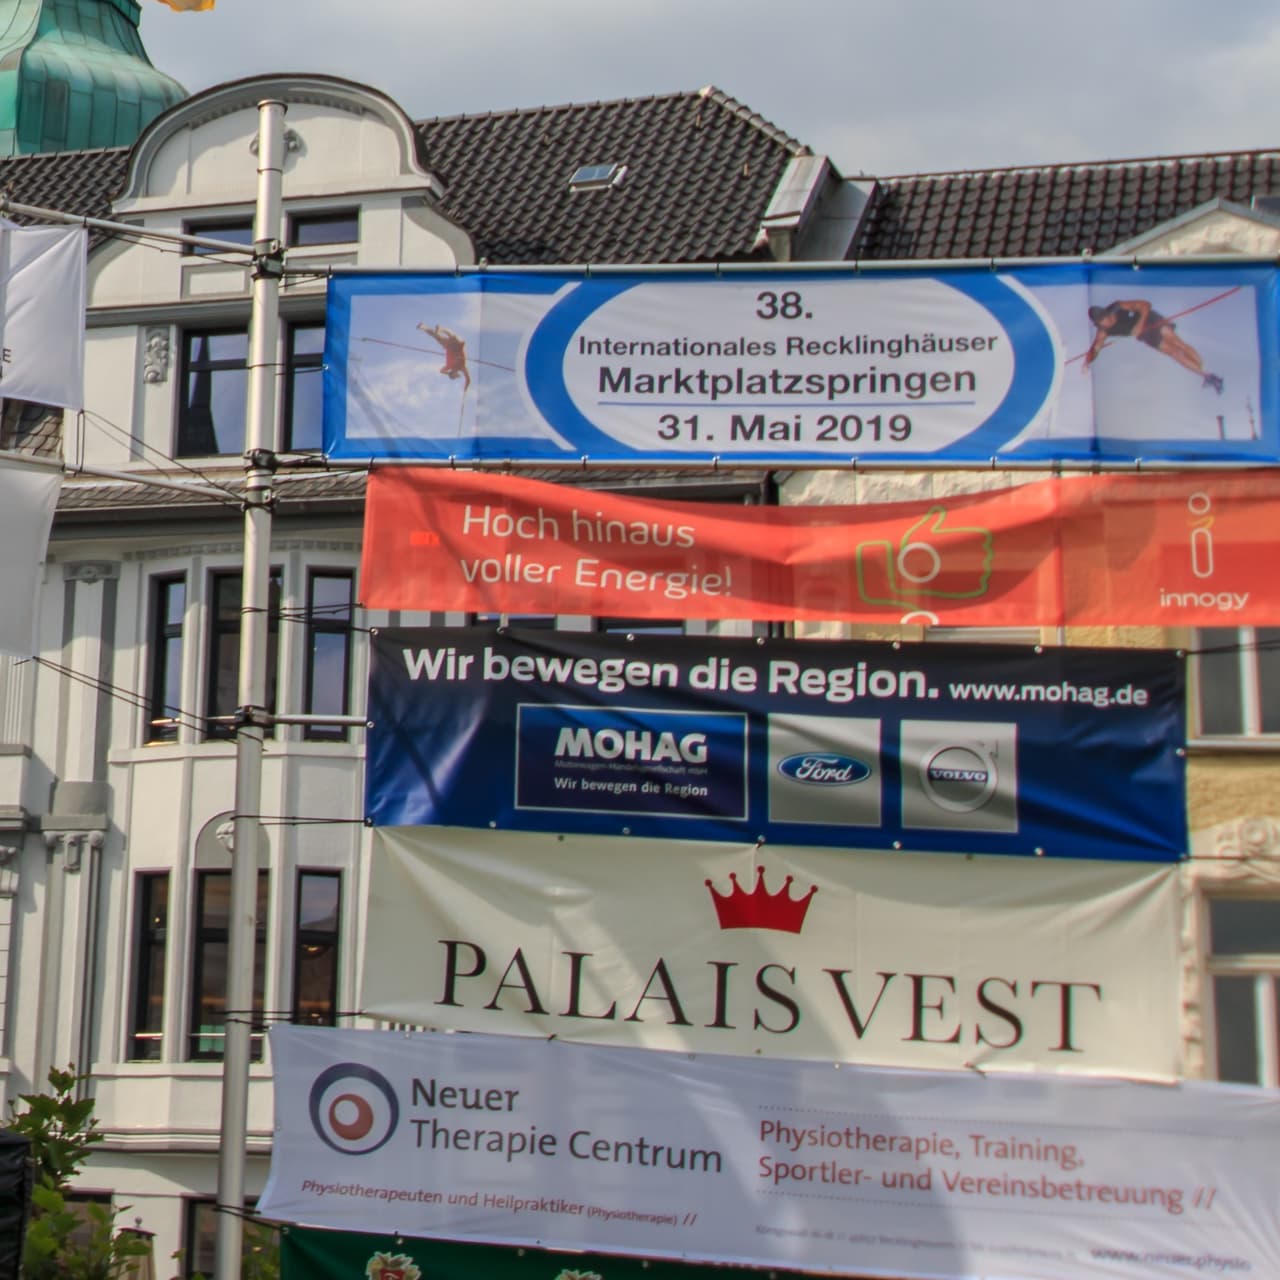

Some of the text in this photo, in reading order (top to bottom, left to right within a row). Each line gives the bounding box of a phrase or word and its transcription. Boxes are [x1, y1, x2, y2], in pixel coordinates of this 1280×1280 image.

[756, 290, 814, 320] 38.
[578, 332, 999, 360] Internationales Recklinghäuser
[598, 365, 977, 402] Marktplatzspringen
[657, 412, 913, 443] 31. Mai 2019
[461, 504, 696, 548] Hoch hinaus
[460, 553, 734, 600] voller Energie!
[1159, 588, 1250, 611] innogy
[401, 647, 1149, 708] Wir bewegen die Region. www.mohag.de
[555, 727, 708, 764] MOHAG
[553, 776, 709, 799] Wir bewegen die Region
[795, 755, 853, 783] Ford
[931, 770, 987, 782] VOLVO
[411, 1078, 520, 1112] Neuer
[409, 1118, 723, 1174] Therapie Centrum
[758, 1119, 1085, 1171] Physiotherapie, Training,
[301, 1179, 443, 1205] Physiotherapeuten
[448, 1190, 479, 1208] und
[483, 1193, 586, 1217] Heilpraktiker
[587, 1204, 679, 1227] (Physiotherapie)
[758, 1155, 873, 1187] Sportler-
[882, 1165, 933, 1191] und
[941, 1167, 1185, 1214] Vereinsbetreuung
